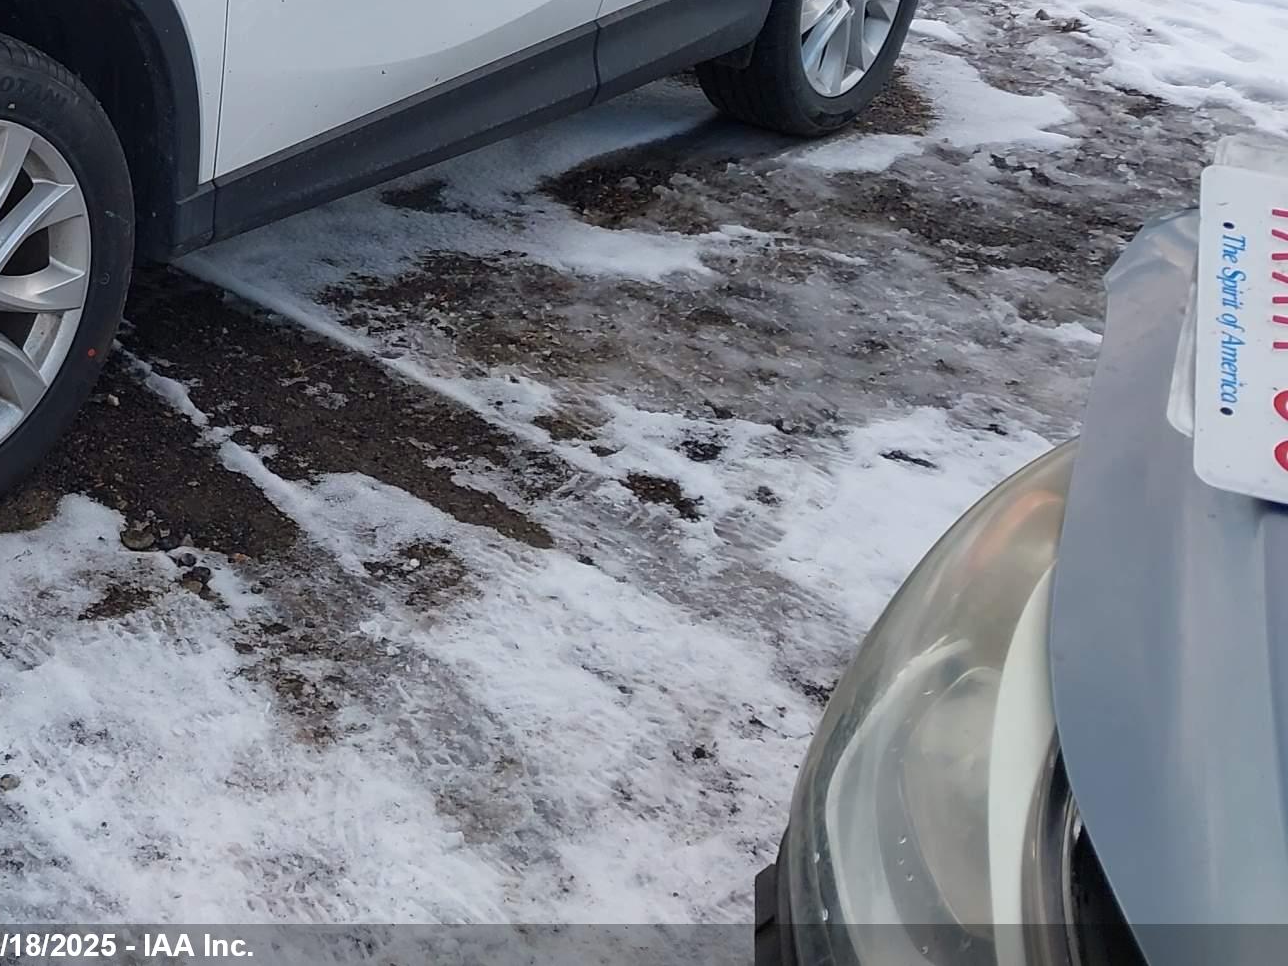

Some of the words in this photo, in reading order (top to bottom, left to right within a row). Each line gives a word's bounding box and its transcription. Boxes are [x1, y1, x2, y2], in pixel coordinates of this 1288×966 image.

[1222, 234, 1247, 264] The
[1217, 266, 1247, 310] Spirit
[1216, 313, 1245, 332] of
[1220, 331, 1246, 404] America
